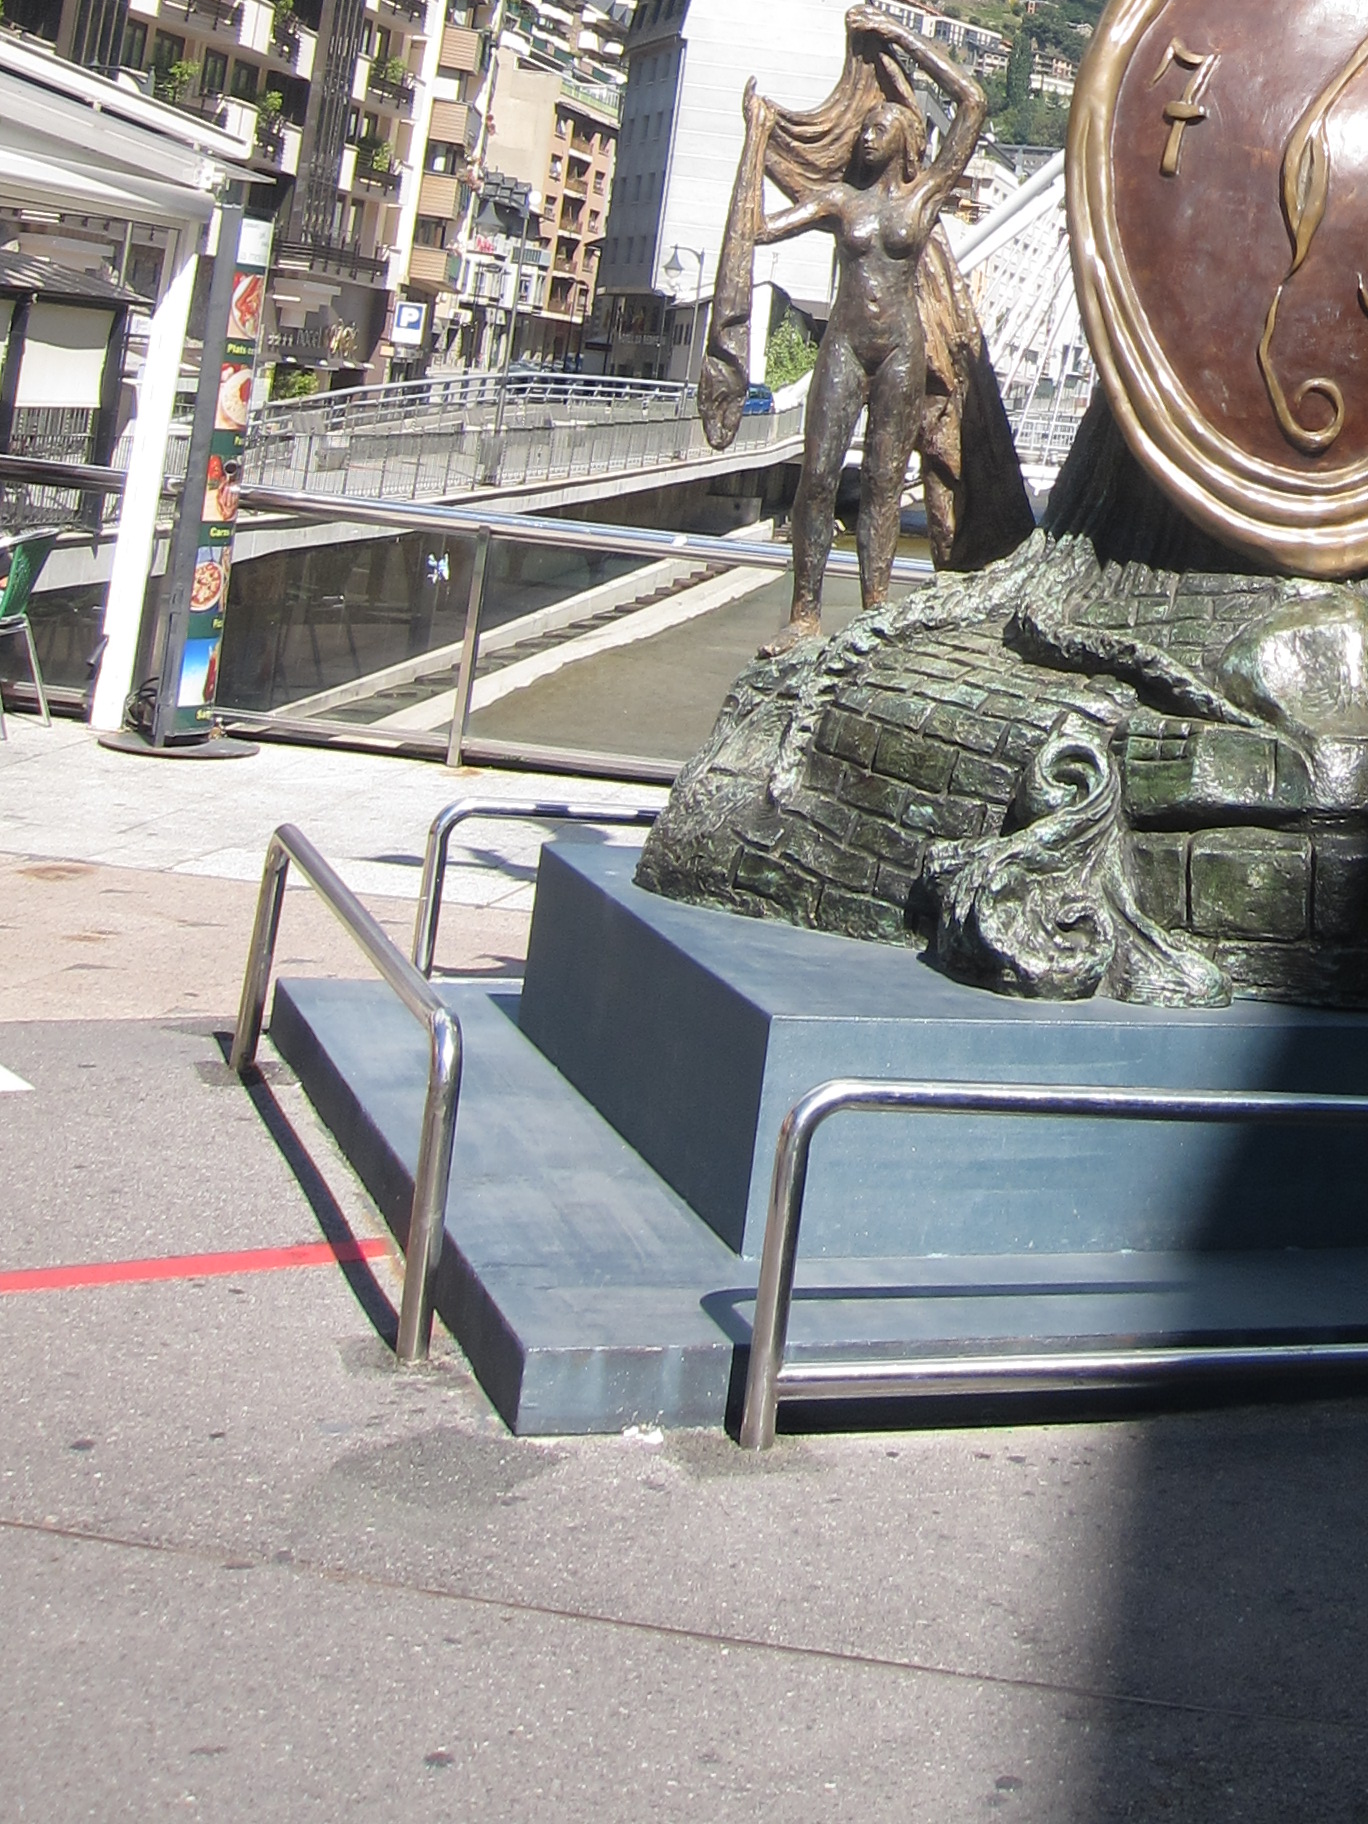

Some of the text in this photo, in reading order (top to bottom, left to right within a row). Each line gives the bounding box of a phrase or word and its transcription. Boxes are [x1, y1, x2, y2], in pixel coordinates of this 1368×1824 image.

[1147, 36, 1222, 176] 7
[400, 306, 420, 327] P
[1257, 283, 1346, 454] 6
